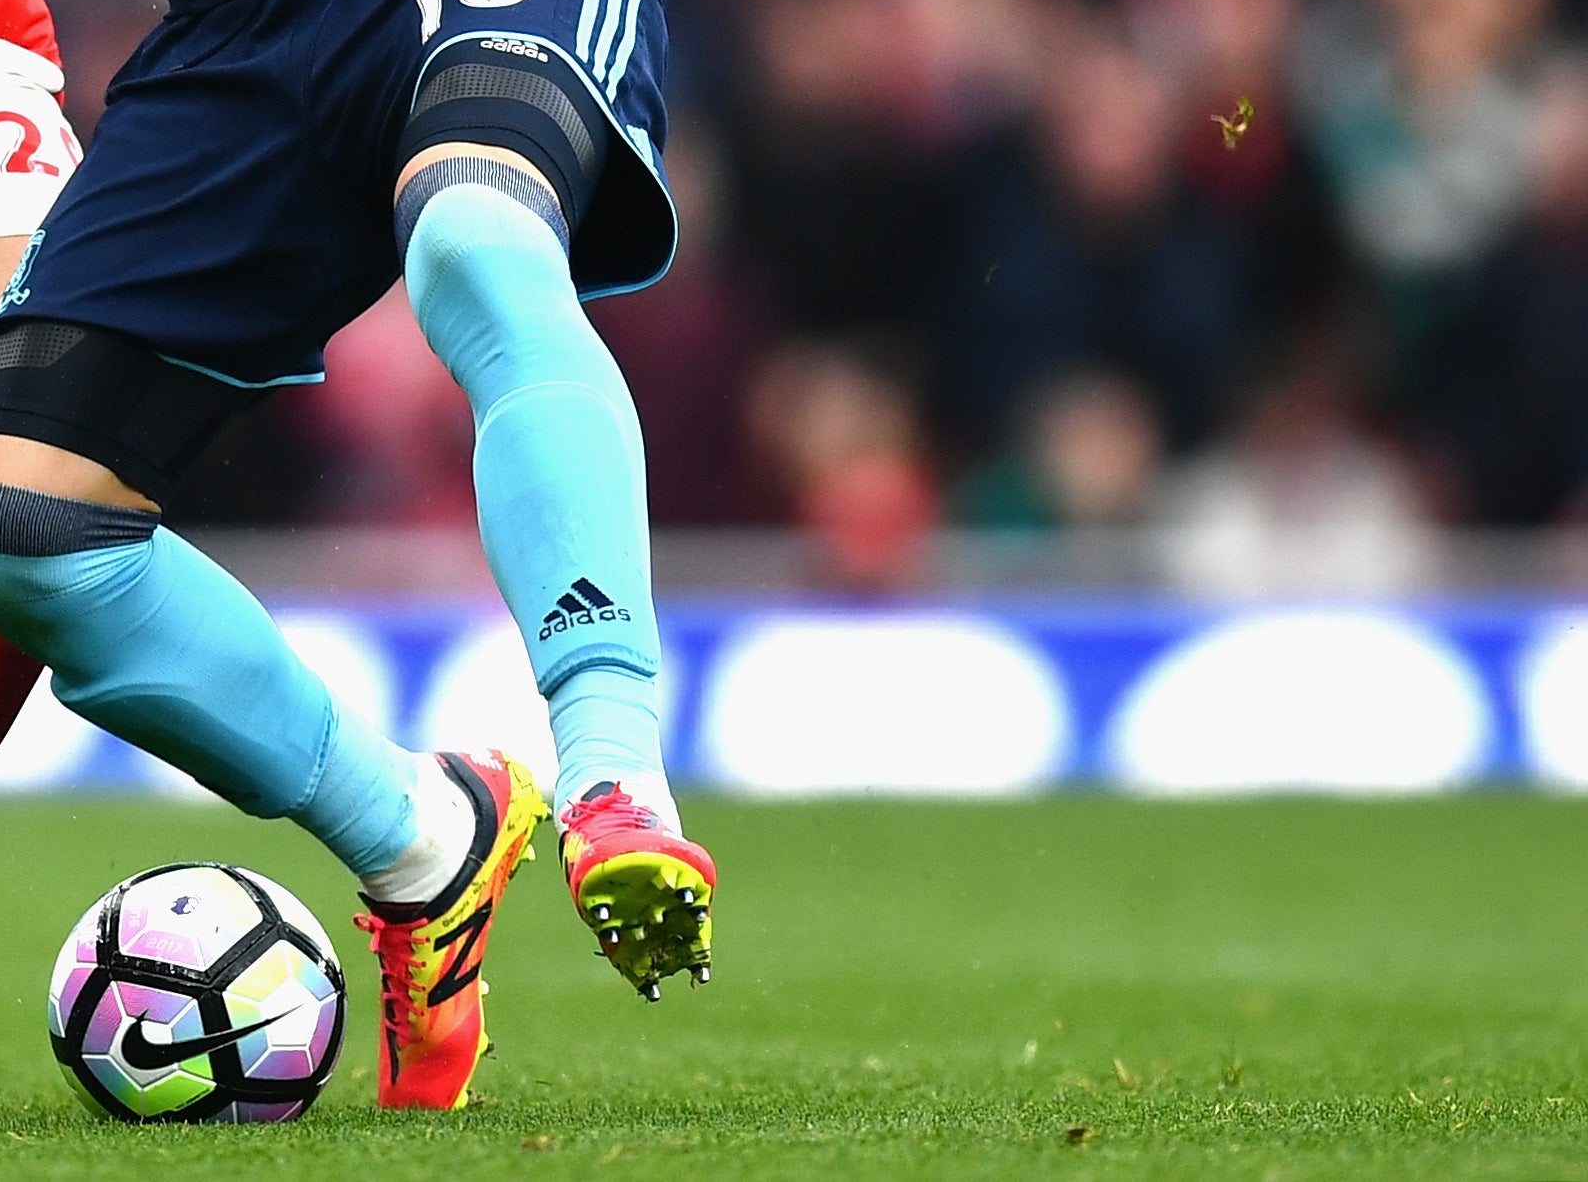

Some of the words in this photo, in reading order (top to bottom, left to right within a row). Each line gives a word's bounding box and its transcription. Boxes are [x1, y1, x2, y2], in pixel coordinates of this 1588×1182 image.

[479, 38, 549, 64] adidas
[538, 608, 631, 642] adidas
[145, 935, 185, 954] 2017
